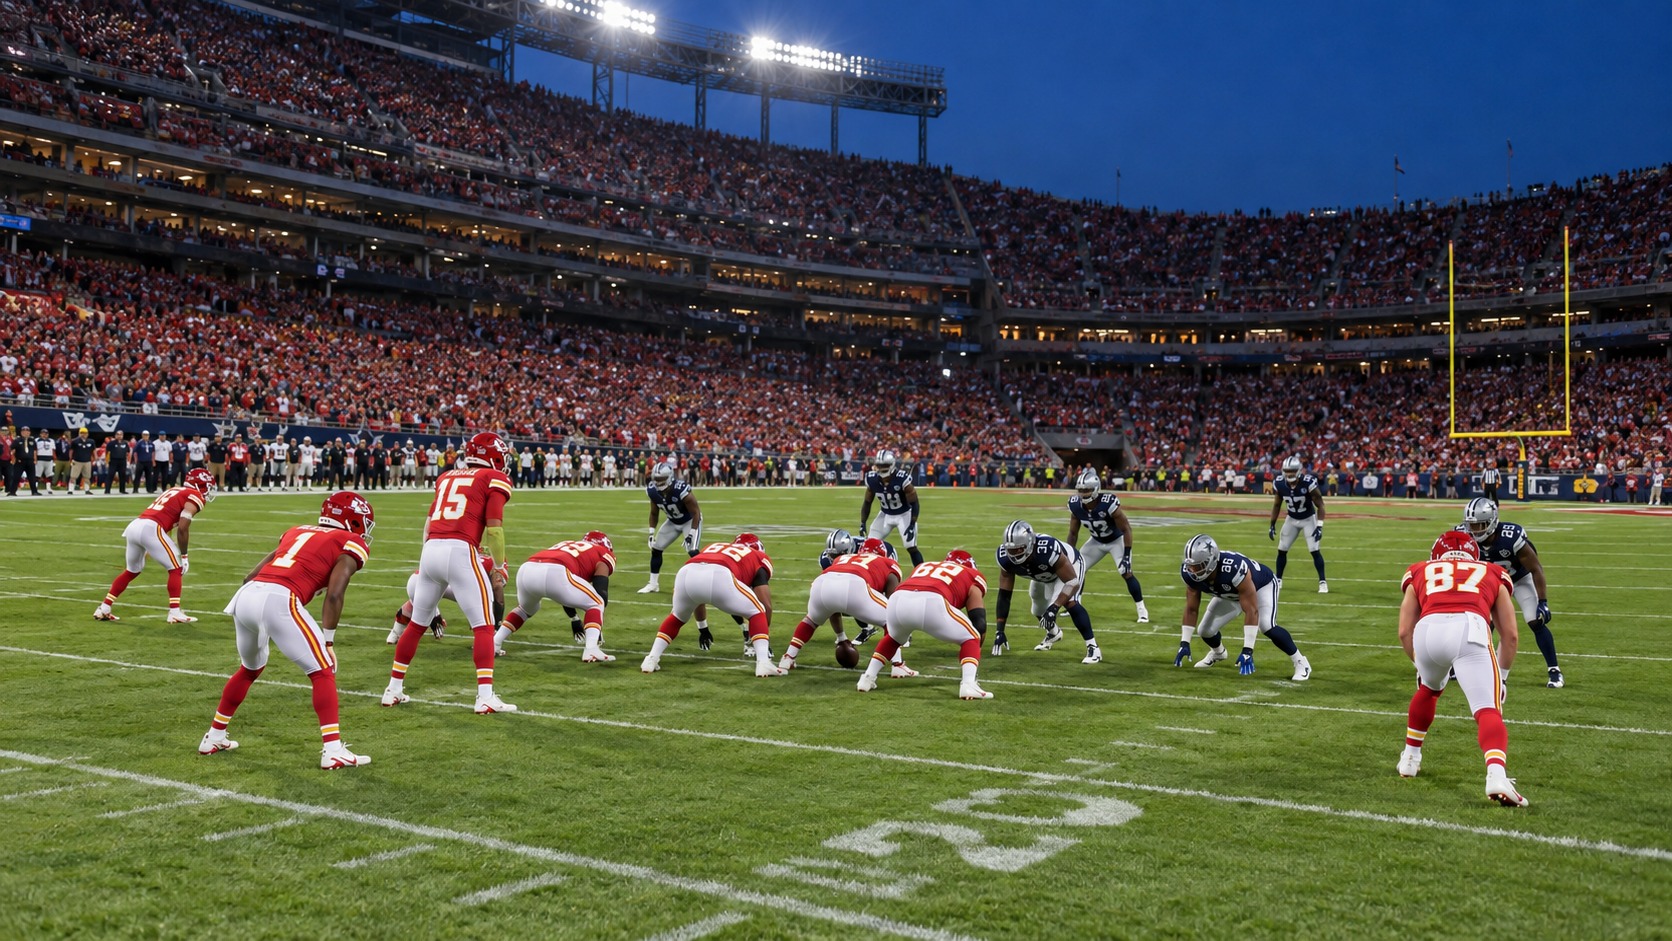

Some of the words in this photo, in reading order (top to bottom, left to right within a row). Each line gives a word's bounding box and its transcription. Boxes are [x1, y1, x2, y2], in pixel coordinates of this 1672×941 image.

[430, 477, 475, 522] 15
[1282, 495, 1307, 513] 27
[270, 531, 317, 569] 1
[702, 542, 753, 563] 62
[910, 561, 964, 585] 62
[1424, 562, 1487, 596] 87
